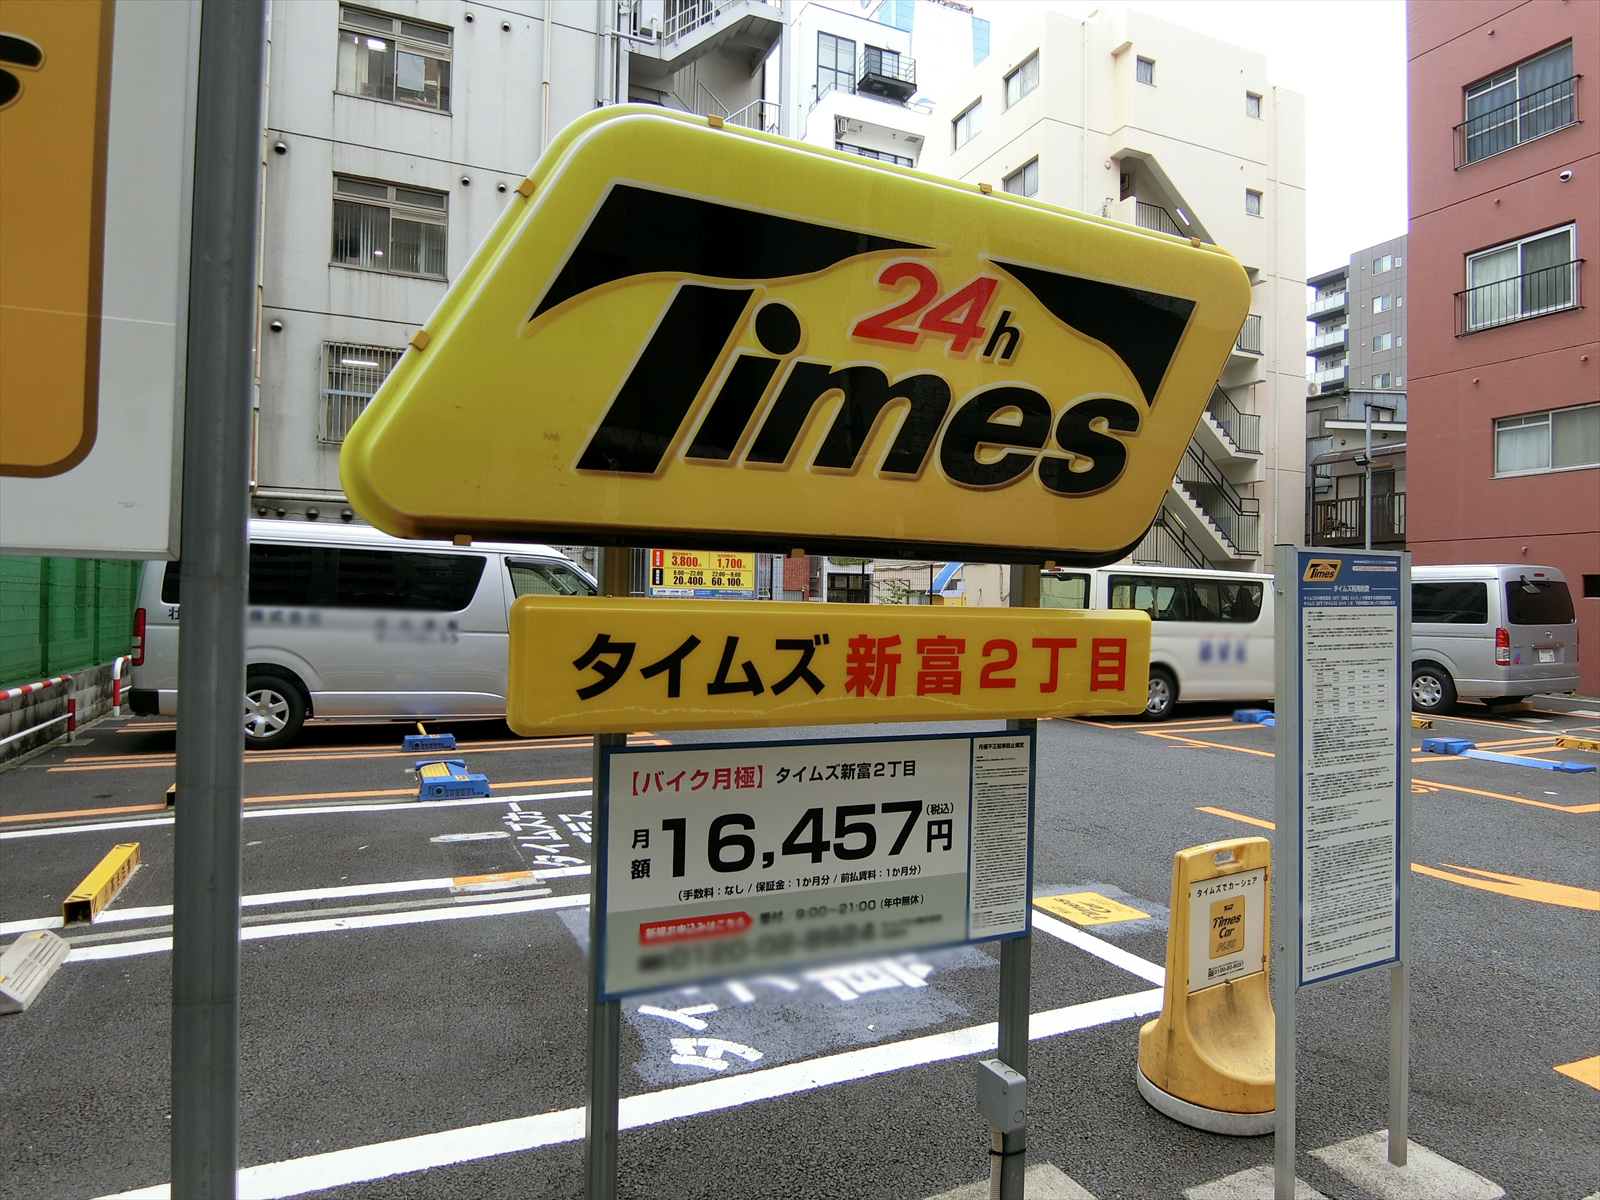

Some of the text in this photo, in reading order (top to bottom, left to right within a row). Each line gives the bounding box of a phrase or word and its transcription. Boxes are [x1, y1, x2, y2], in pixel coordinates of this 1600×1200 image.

[851, 260, 1020, 361] 24h
[574, 283, 1141, 496] Times
[1309, 566, 1336, 580] Times
[632, 760, 916, 797] 【バイク月極】 タイムズ新富2丁目
[926, 802, 954, 816] (税込)
[661, 800, 923, 878] 16,457
[926, 818, 953, 853] 円
[1196, 876, 1258, 898] タイムズでカーシェア
[880, 893, 924, 910] (年中無休)
[1212, 913, 1242, 930] Times
[1218, 927, 1235, 939] Car
